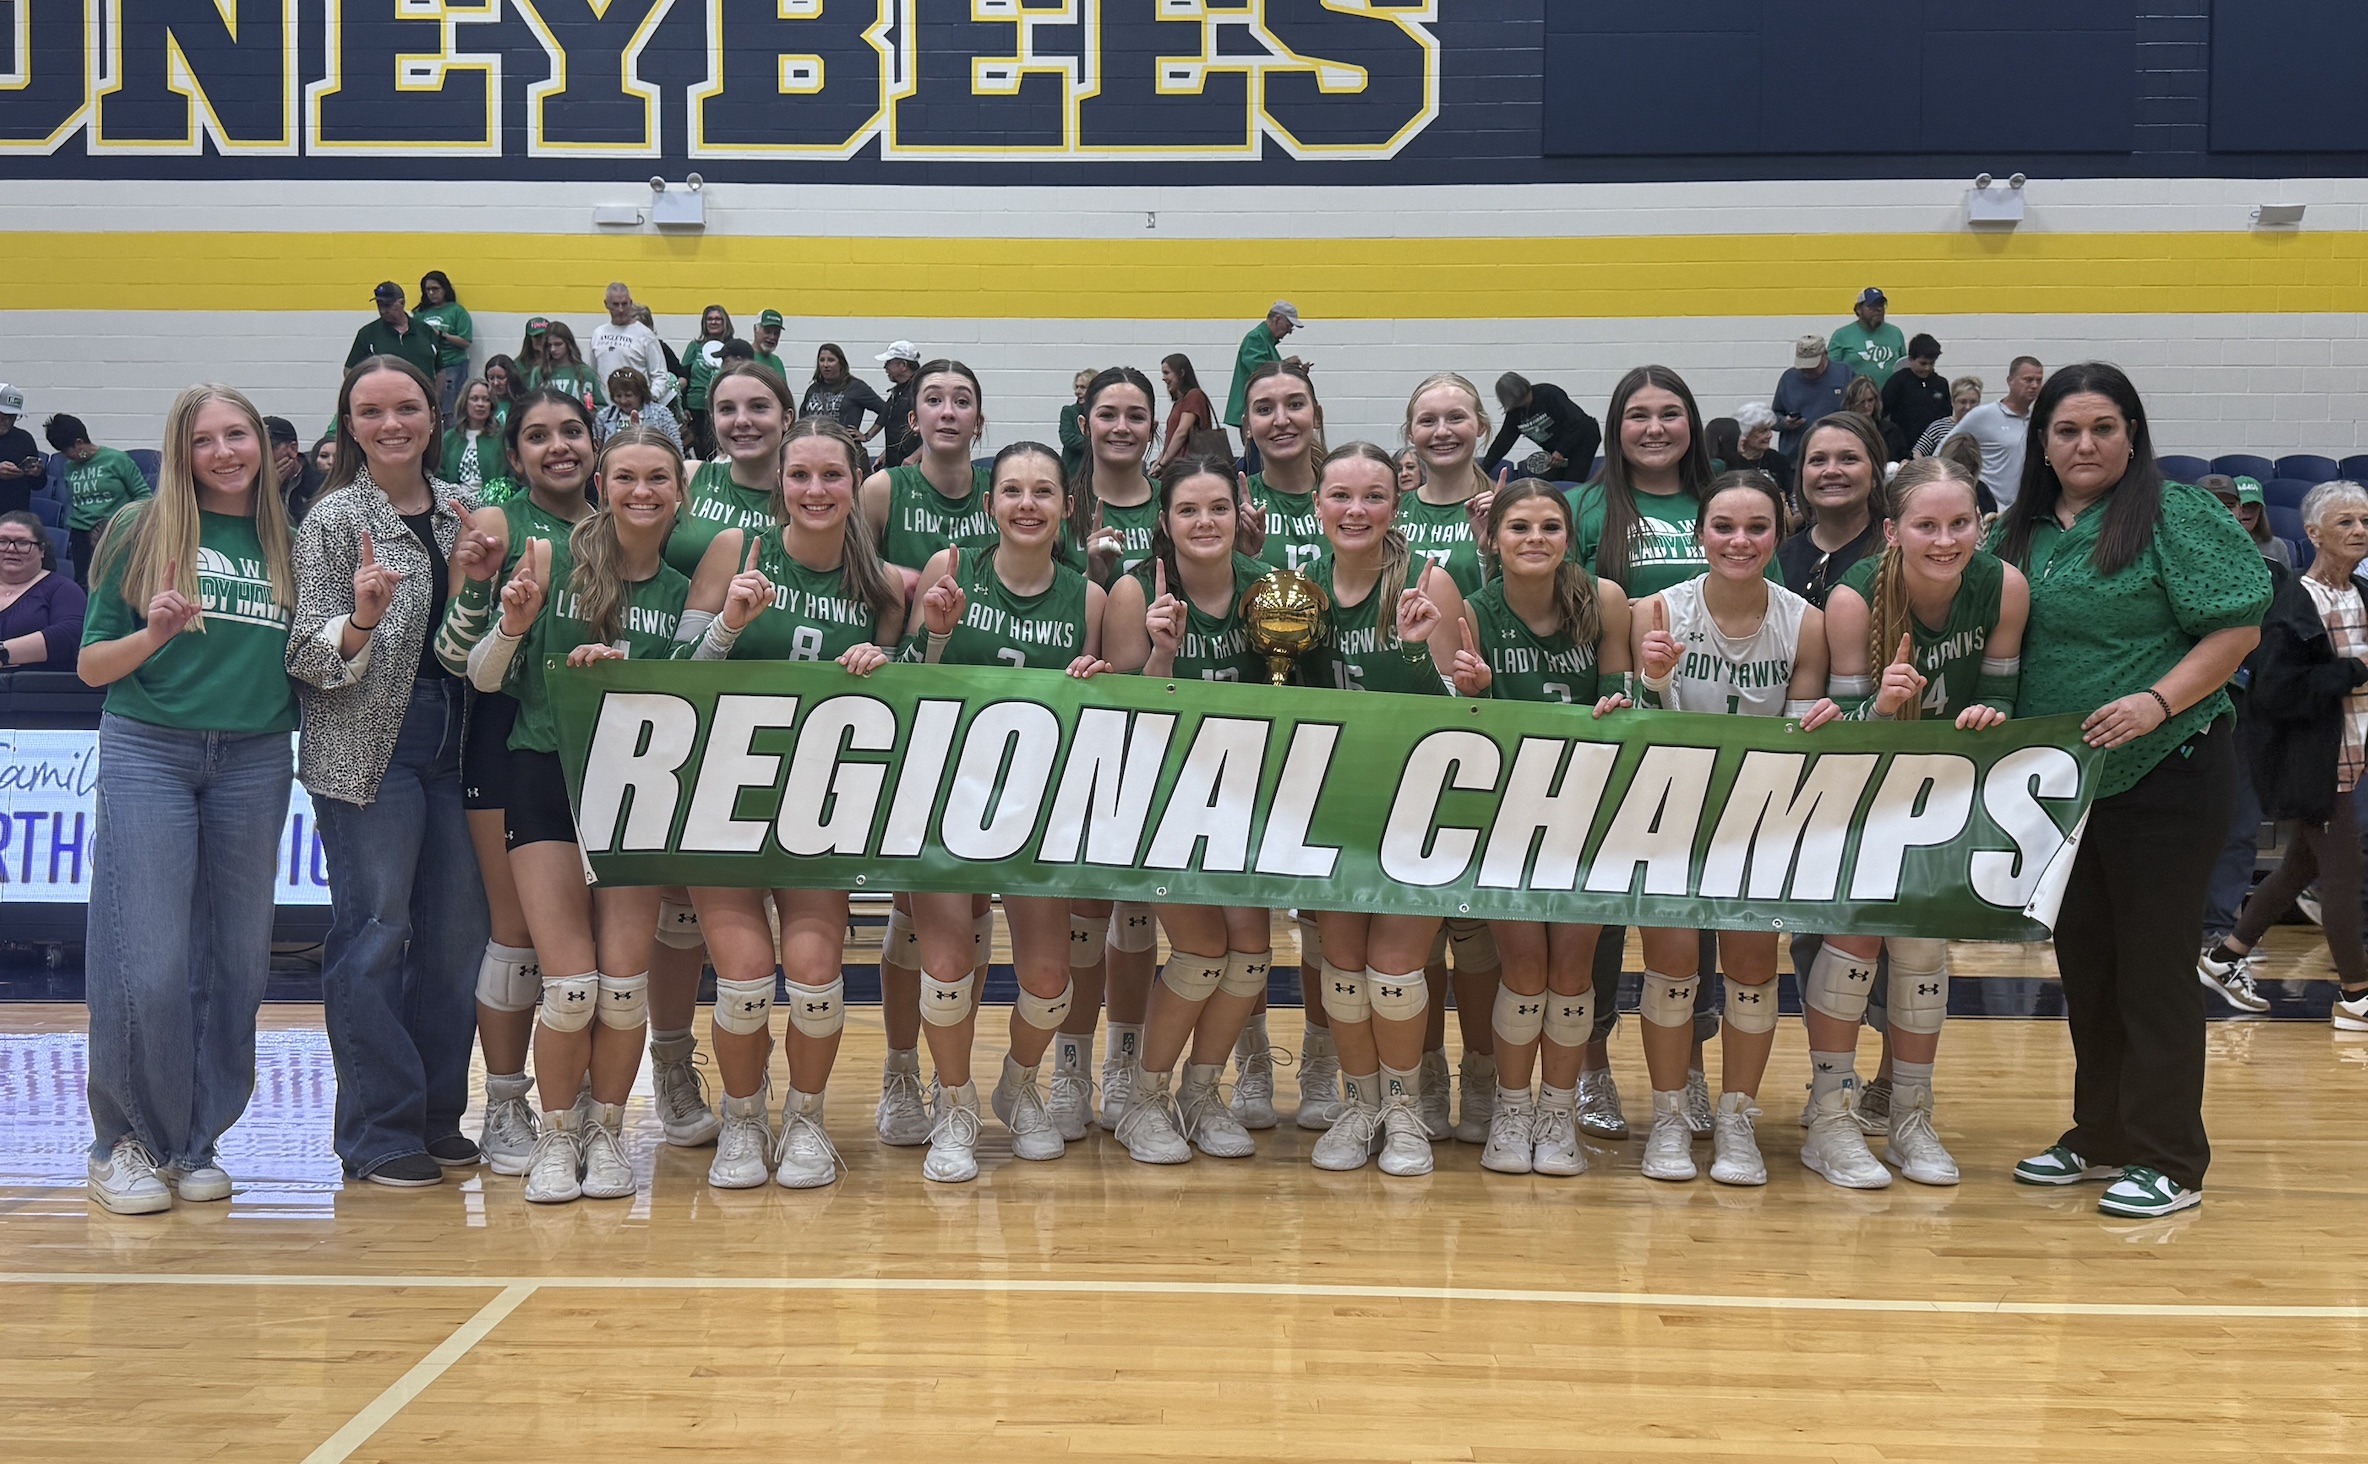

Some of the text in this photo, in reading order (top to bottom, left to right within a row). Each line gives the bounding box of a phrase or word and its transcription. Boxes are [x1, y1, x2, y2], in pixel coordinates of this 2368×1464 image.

[0, 0, 1441, 160] NEYBEES
[70, 465, 104, 481] GAME
[73, 479, 98, 494] DAY
[689, 496, 736, 524] LADY
[904, 507, 1000, 540] LADY HAWK
[804, 592, 868, 627] HAWKS
[957, 602, 1074, 648] ADY HAWKS
[789, 625, 823, 660] 8
[1493, 647, 1540, 673] LADY
[1678, 652, 1722, 682] ADY
[1726, 695, 1740, 714] 1
[1922, 672, 1949, 716] 4
[578, 690, 2081, 908] REGIONAL CHAMPS
